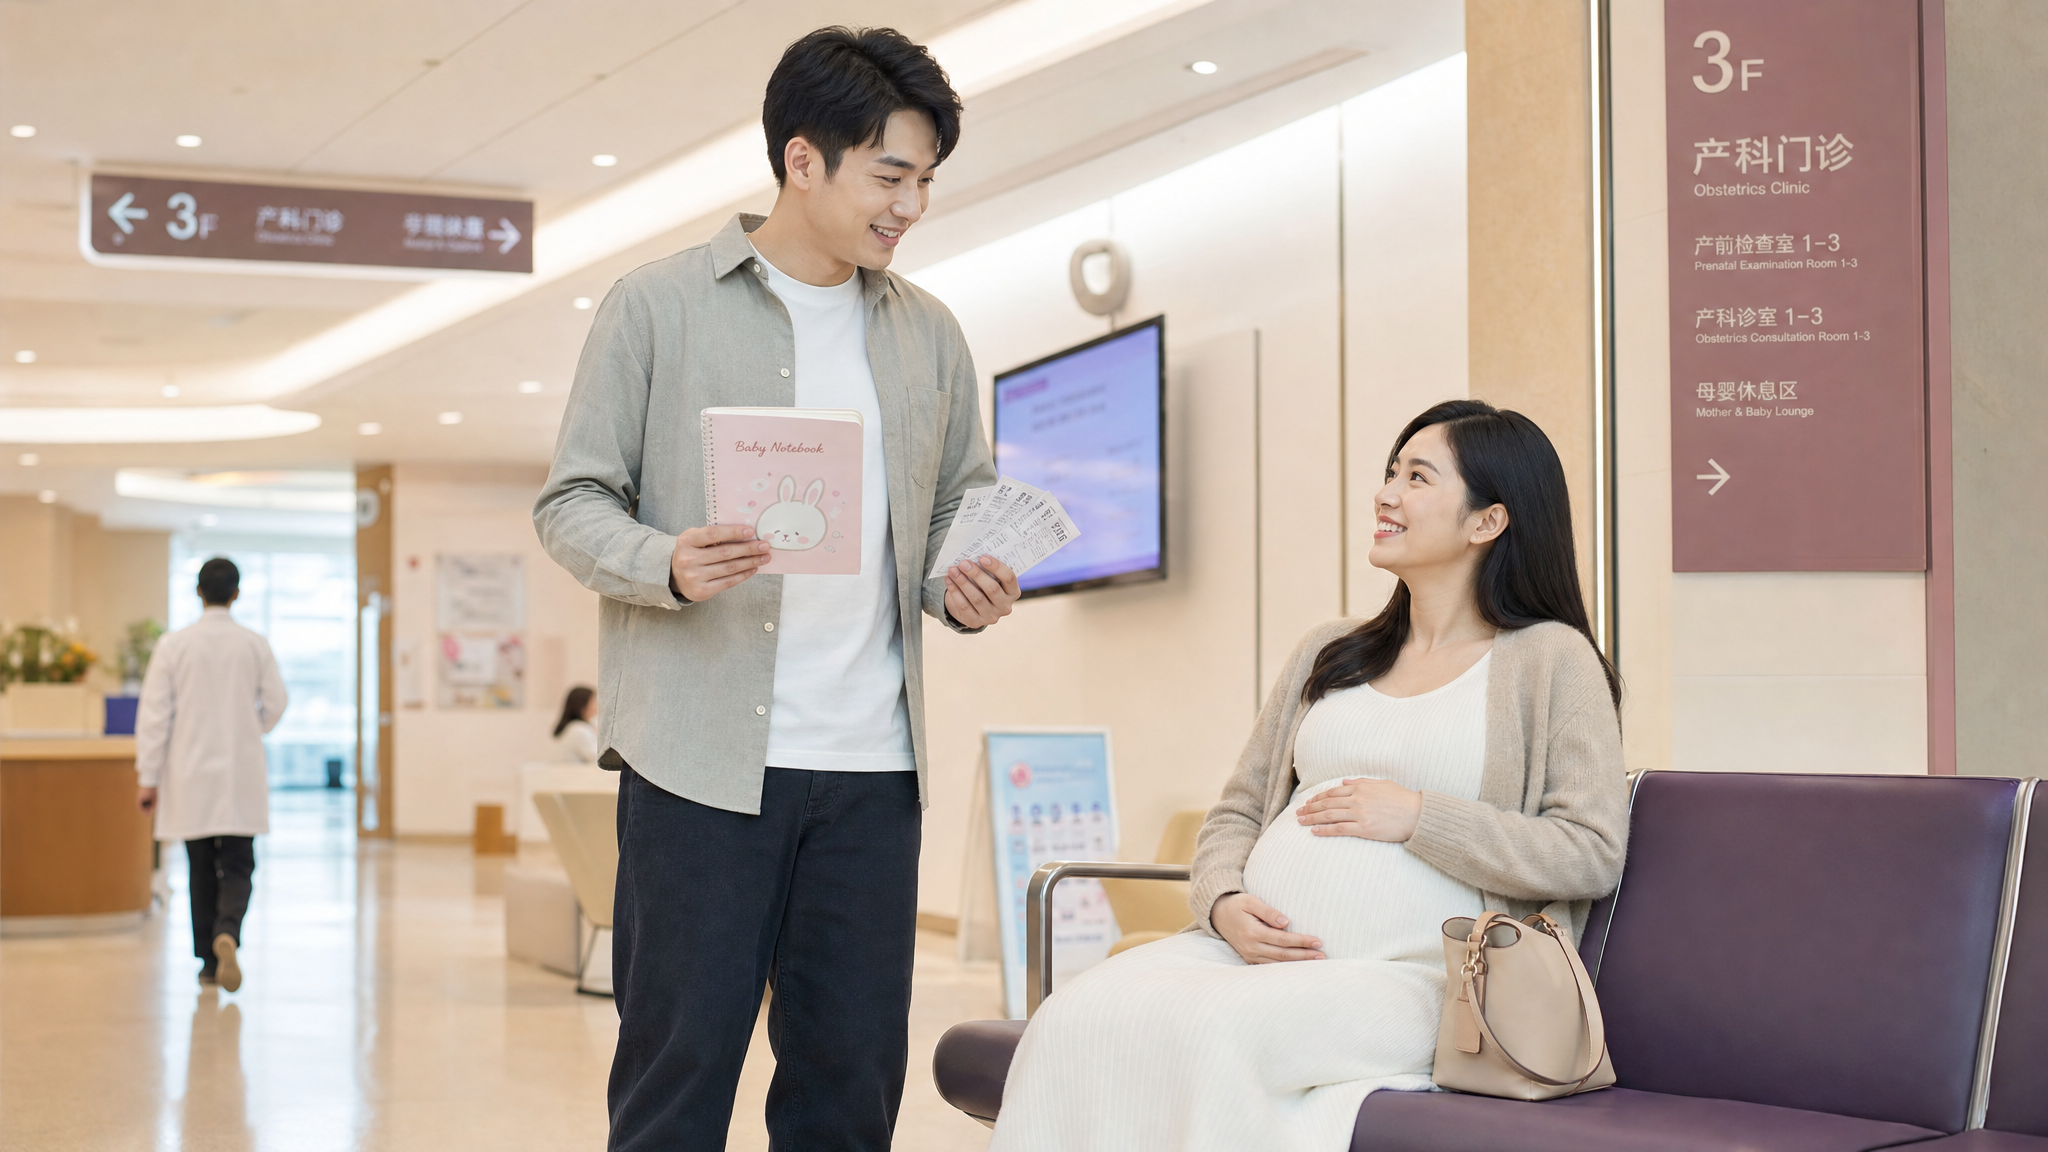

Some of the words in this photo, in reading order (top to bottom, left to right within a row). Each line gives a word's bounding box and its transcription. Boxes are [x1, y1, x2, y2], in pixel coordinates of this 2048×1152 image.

[1693, 30, 1764, 93] 3F
[1693, 133, 1854, 175] 产科门诊
[1694, 181, 1766, 196] Obstetrics
[1770, 181, 1810, 195] Clinic
[1694, 233, 1795, 255] 产前检查室
[1694, 260, 1737, 271] Prenatal
[1740, 258, 1803, 270] Examination
[1806, 258, 1837, 269] Room
[1841, 258, 1858, 268] 1-3
[1695, 306, 1778, 328] 产科诊室
[1695, 332, 1748, 344] Obstetrics
[1750, 331, 1815, 343] Consultation
[1818, 331, 1850, 342] Room
[1853, 331, 1871, 341] 1-3
[1695, 380, 1798, 402] 母婴休息区
[1696, 407, 1732, 417] Mother
[1735, 406, 1743, 417] &
[1746, 406, 1773, 418] Baby
[1775, 405, 1815, 418] Lounge
[734, 440, 767, 458] Baby
[770, 441, 825, 454] Notebook
